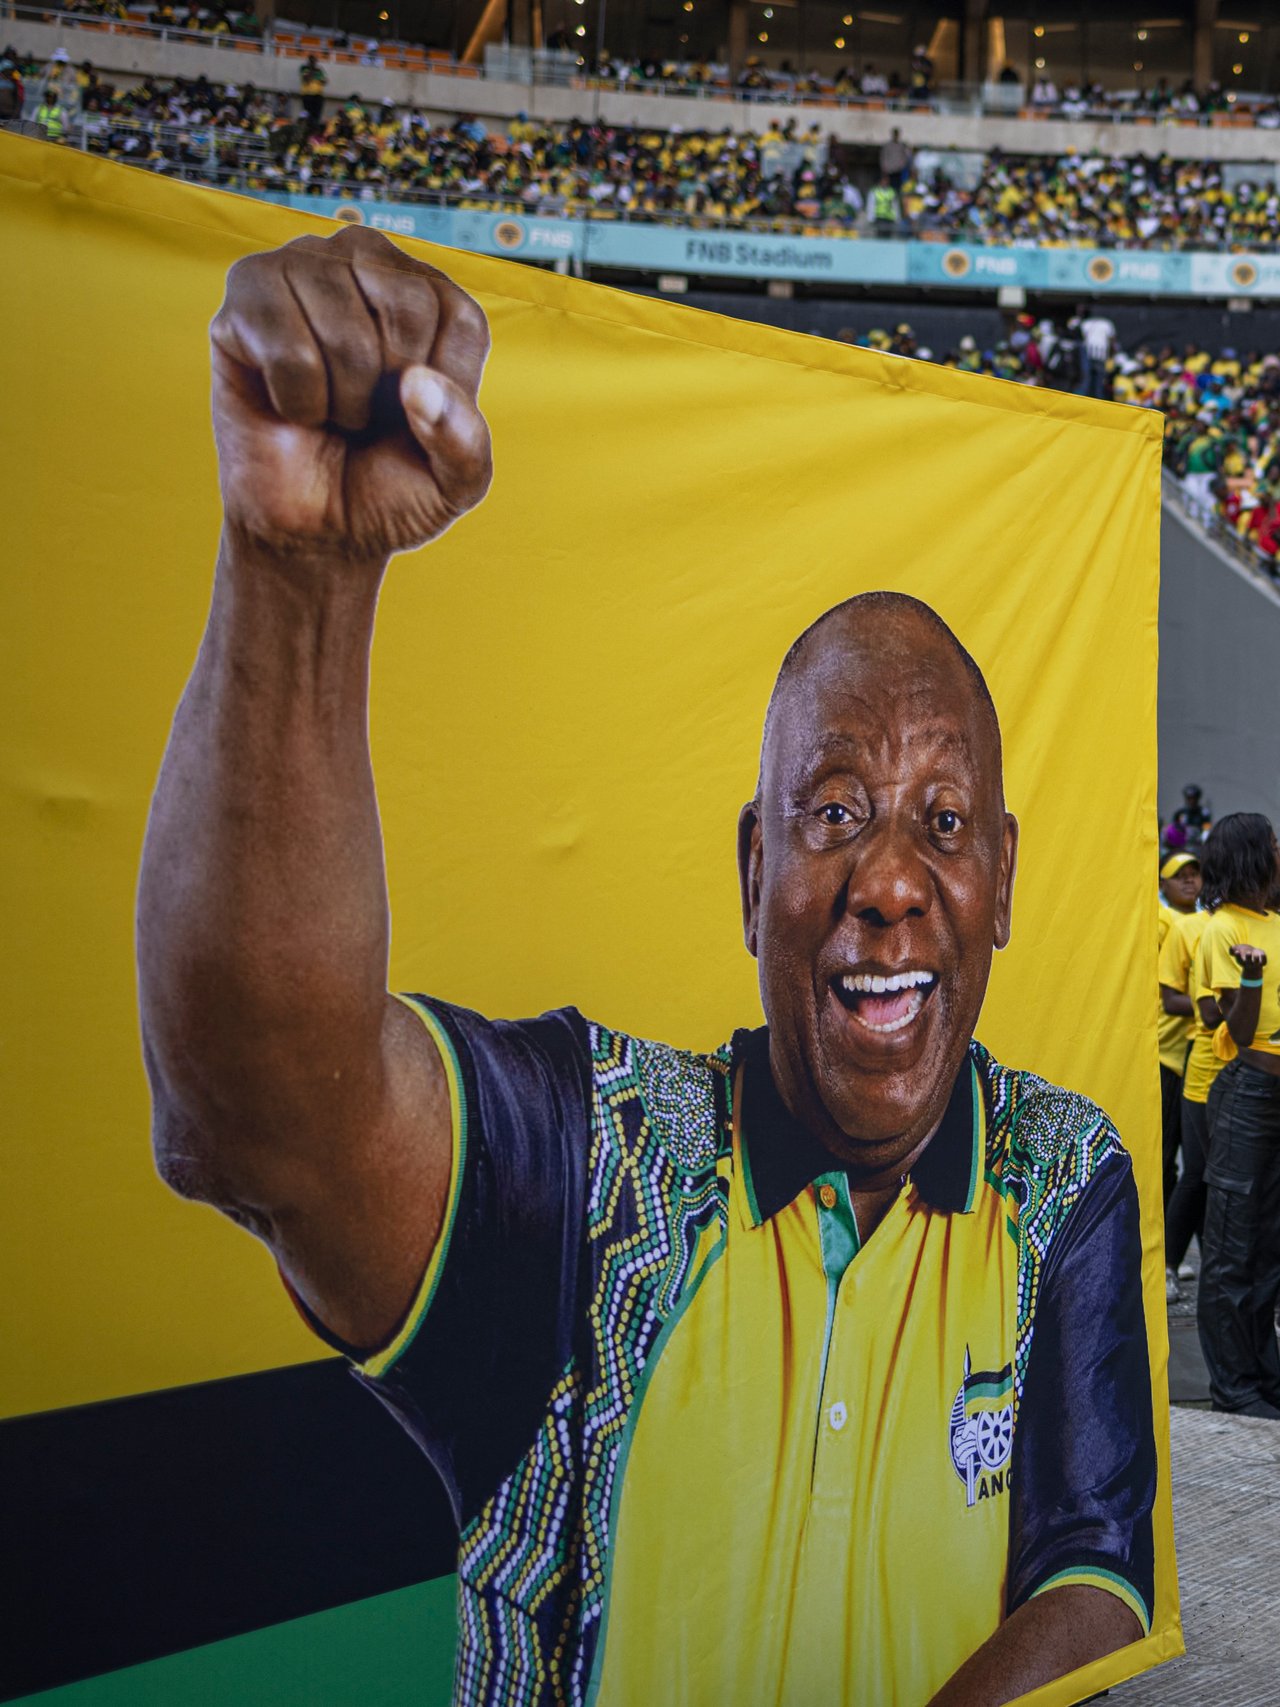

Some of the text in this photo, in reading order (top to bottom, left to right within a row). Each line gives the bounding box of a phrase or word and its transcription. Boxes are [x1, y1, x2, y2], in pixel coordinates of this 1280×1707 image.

[371, 213, 415, 233] FNB
[529, 229, 573, 248] FNB
[686, 239, 833, 269] FNB Stadium
[975, 255, 1017, 275] FNB
[1119, 262, 1160, 280] FNB
